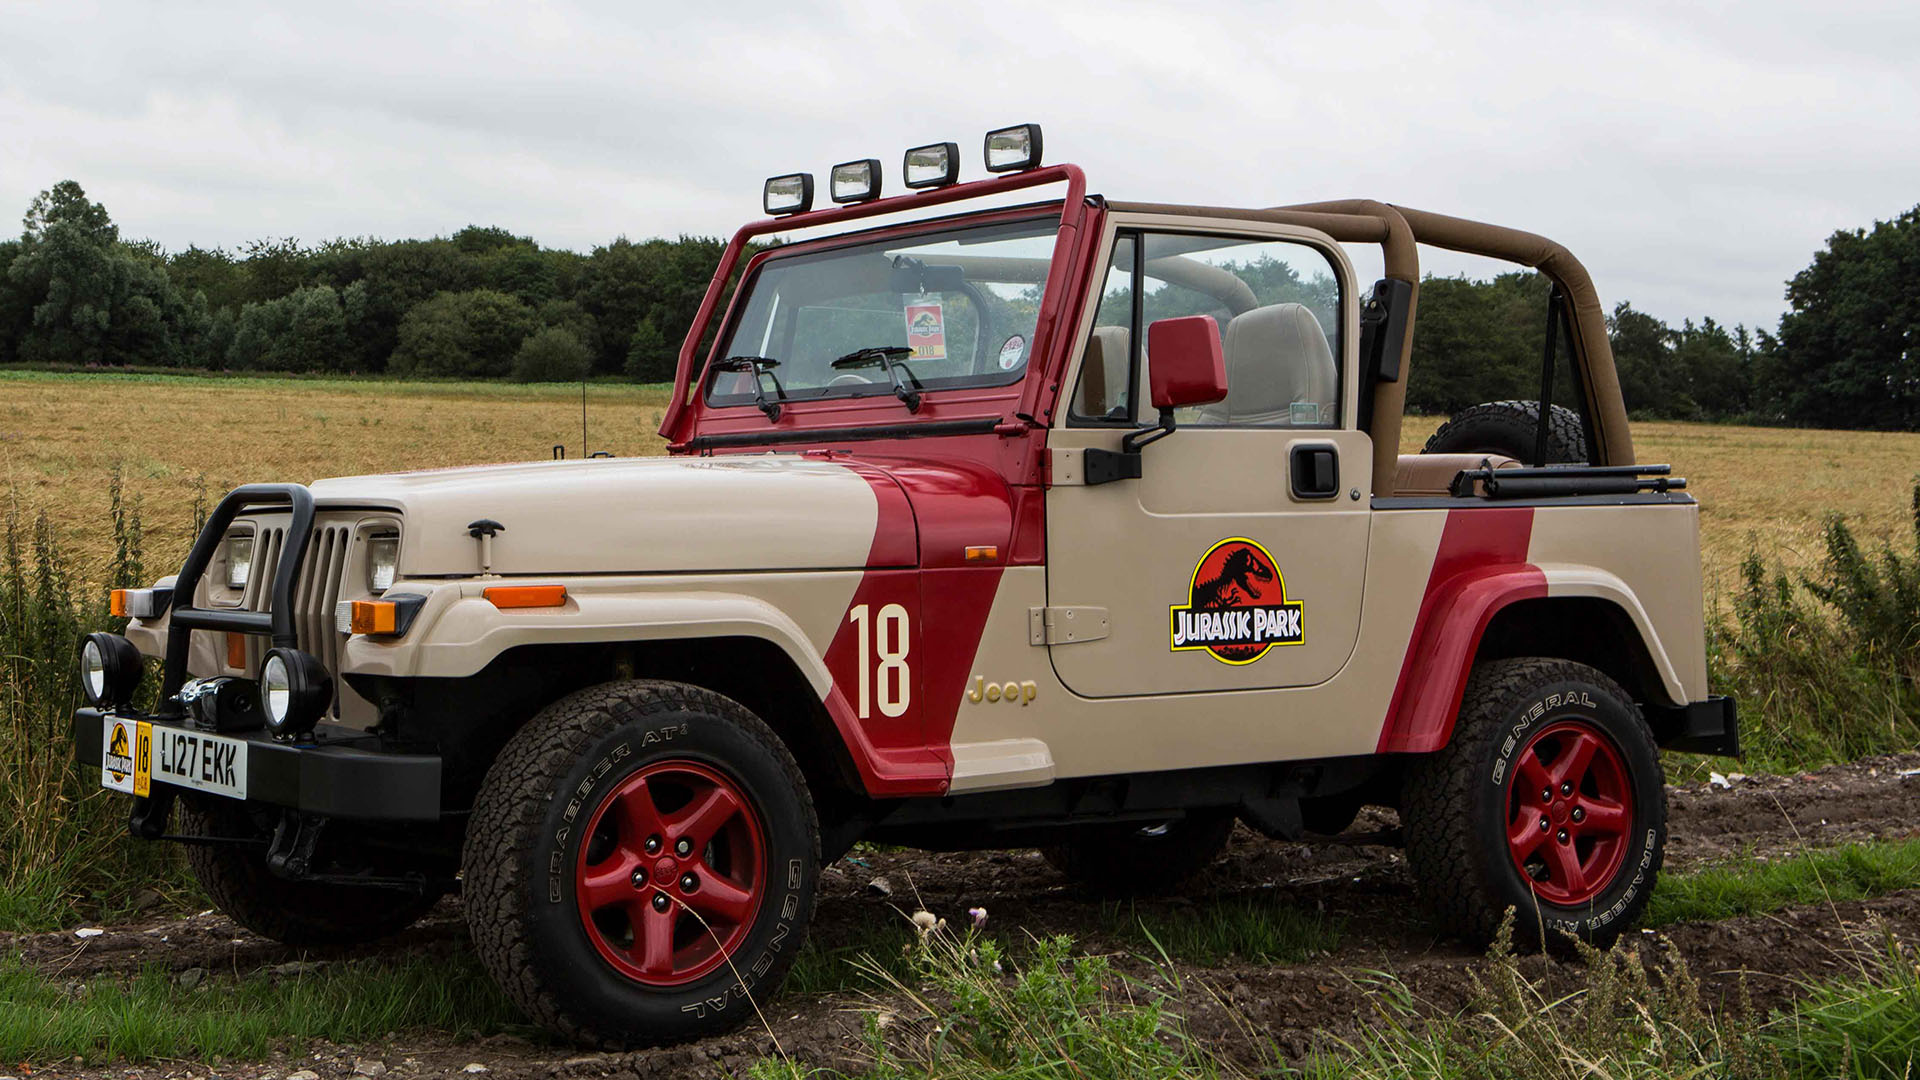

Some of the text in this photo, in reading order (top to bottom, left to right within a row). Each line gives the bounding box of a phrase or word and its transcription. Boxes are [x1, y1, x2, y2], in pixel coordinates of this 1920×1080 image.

[850, 603, 910, 719] 18
[1174, 608, 1301, 645] JURASSIC PARK
[967, 675, 1037, 707] Jeep
[1492, 691, 1597, 785] GENERAL
[138, 734, 149, 774] 18
[161, 732, 237, 788] L127 EKK
[550, 743, 632, 903] GRABBER
[1587, 828, 1657, 931] GRABBER
[681, 859, 802, 1019] GENERAL
